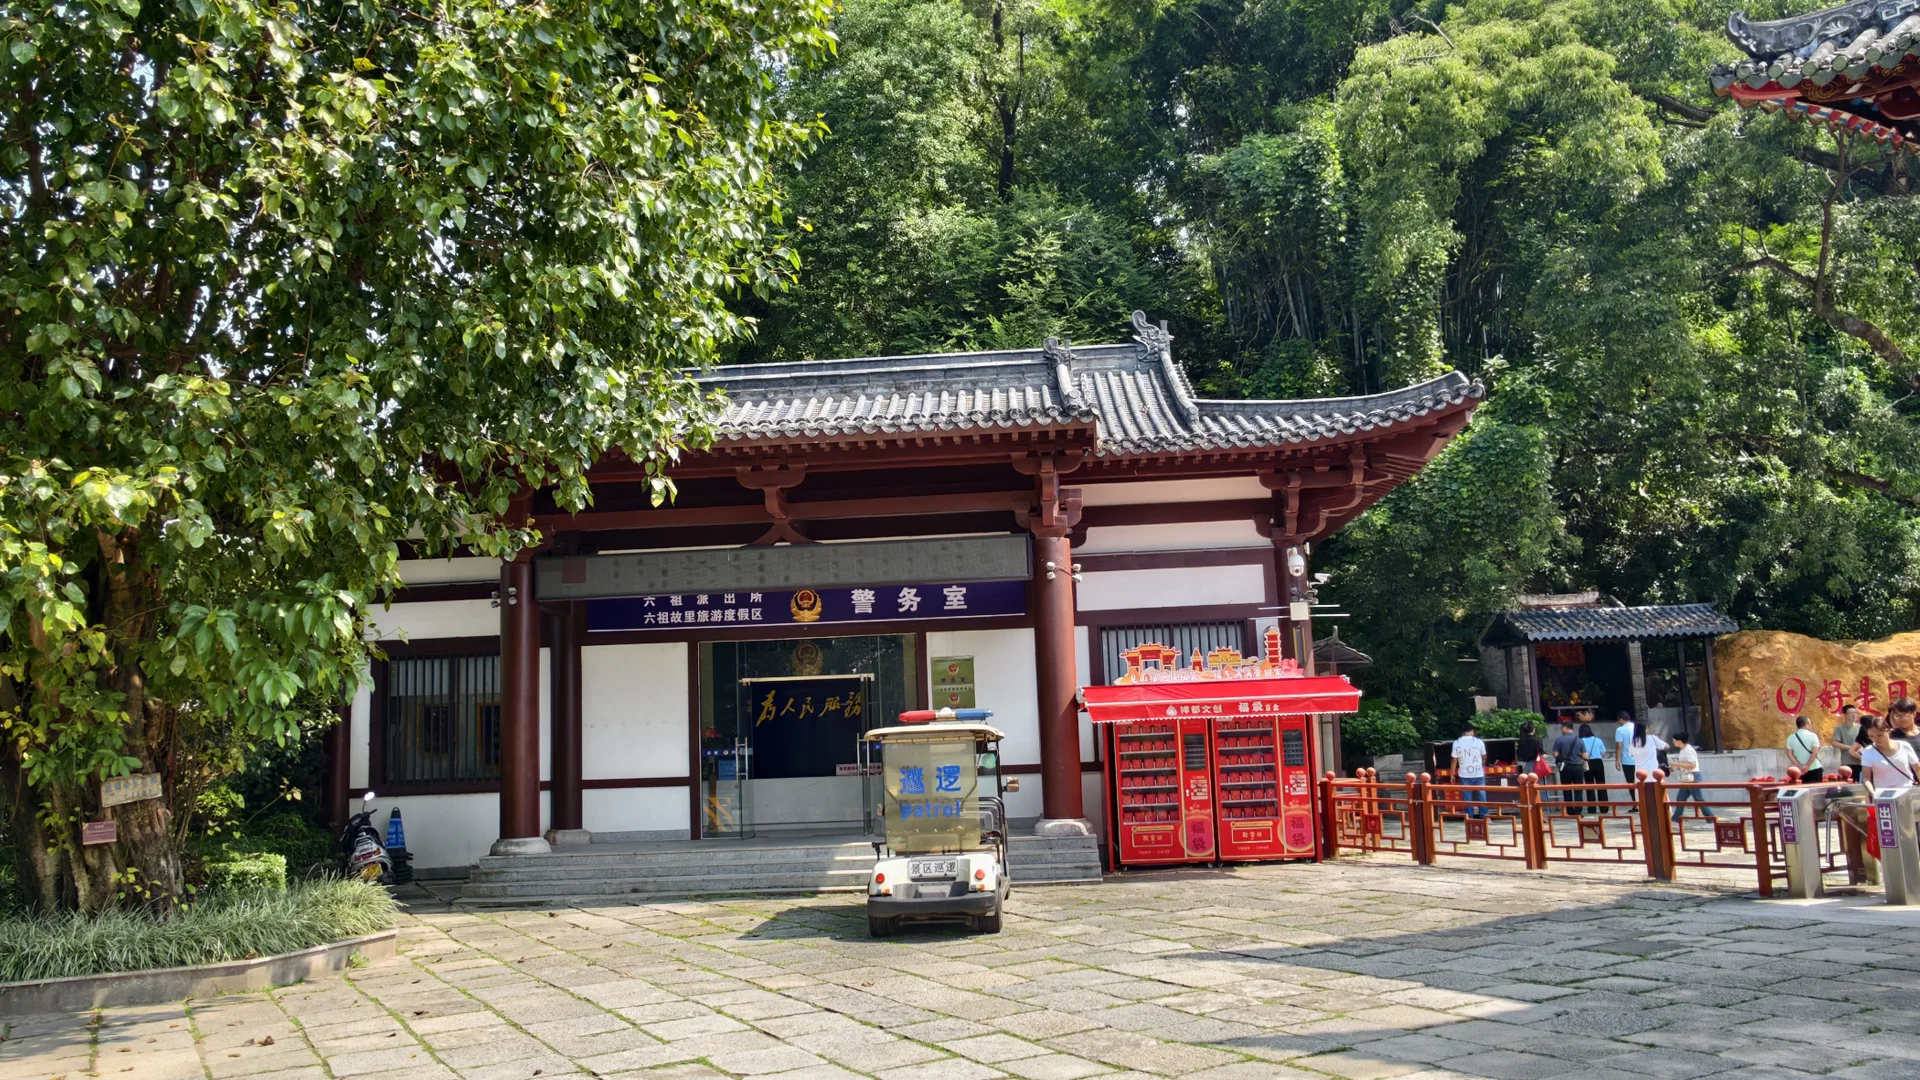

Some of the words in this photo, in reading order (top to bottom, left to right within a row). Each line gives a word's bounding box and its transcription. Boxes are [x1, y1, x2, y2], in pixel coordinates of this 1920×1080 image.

[643, 592, 763, 607] 六祖派出所
[851, 585, 967, 614] 警务室
[643, 608, 763, 624] 六祖故里旅游度假区
[899, 765, 962, 795] 巡逻
[901, 800, 962, 820] patrol
[1781, 804, 1794, 827] 出口
[1879, 806, 1892, 830] 出口
[911, 862, 956, 875] 景区巡逻
